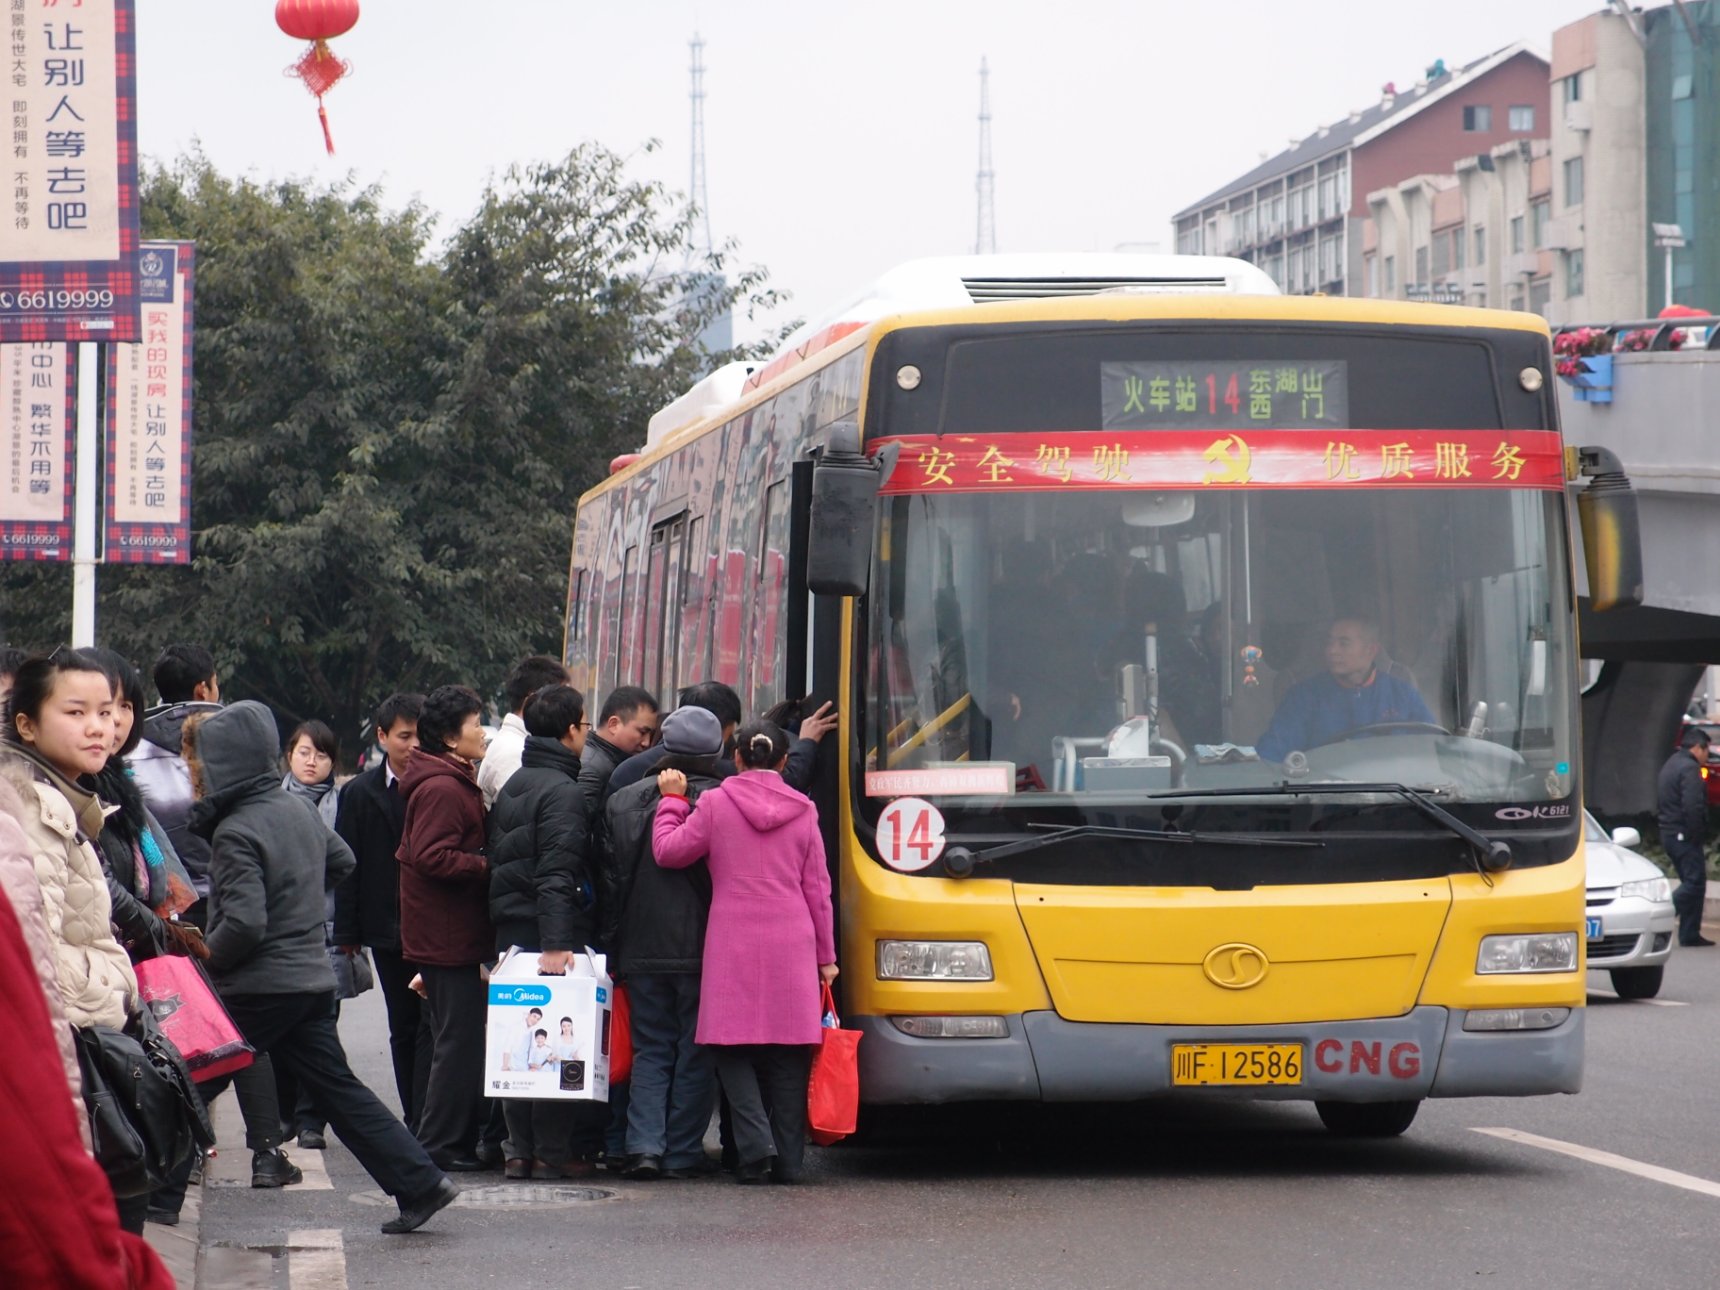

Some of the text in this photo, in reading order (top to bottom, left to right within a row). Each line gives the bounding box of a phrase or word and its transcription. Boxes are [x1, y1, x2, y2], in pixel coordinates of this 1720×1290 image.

[13, 100, 28, 158] 即刻拥有
[43, 22, 87, 230] 让别人等去吧
[14, 171, 29, 230] 不再等待
[17, 289, 114, 309] 6619999
[147, 311, 168, 397] 买我的现房
[1123, 375, 1197, 413] 火车站
[1206, 373, 1240, 415] 14
[30, 404, 52, 494] 繁华不用等
[145, 404, 166, 507] 让别人等去吧
[917, 441, 1527, 485] 安全驾驶 优质服务
[12, 534, 60, 544] 6619999
[129, 535, 177, 546] 6619999
[887, 809, 934, 861] 14
[516, 990, 544, 1001] Midea
[1315, 1038, 1421, 1080] CNG
